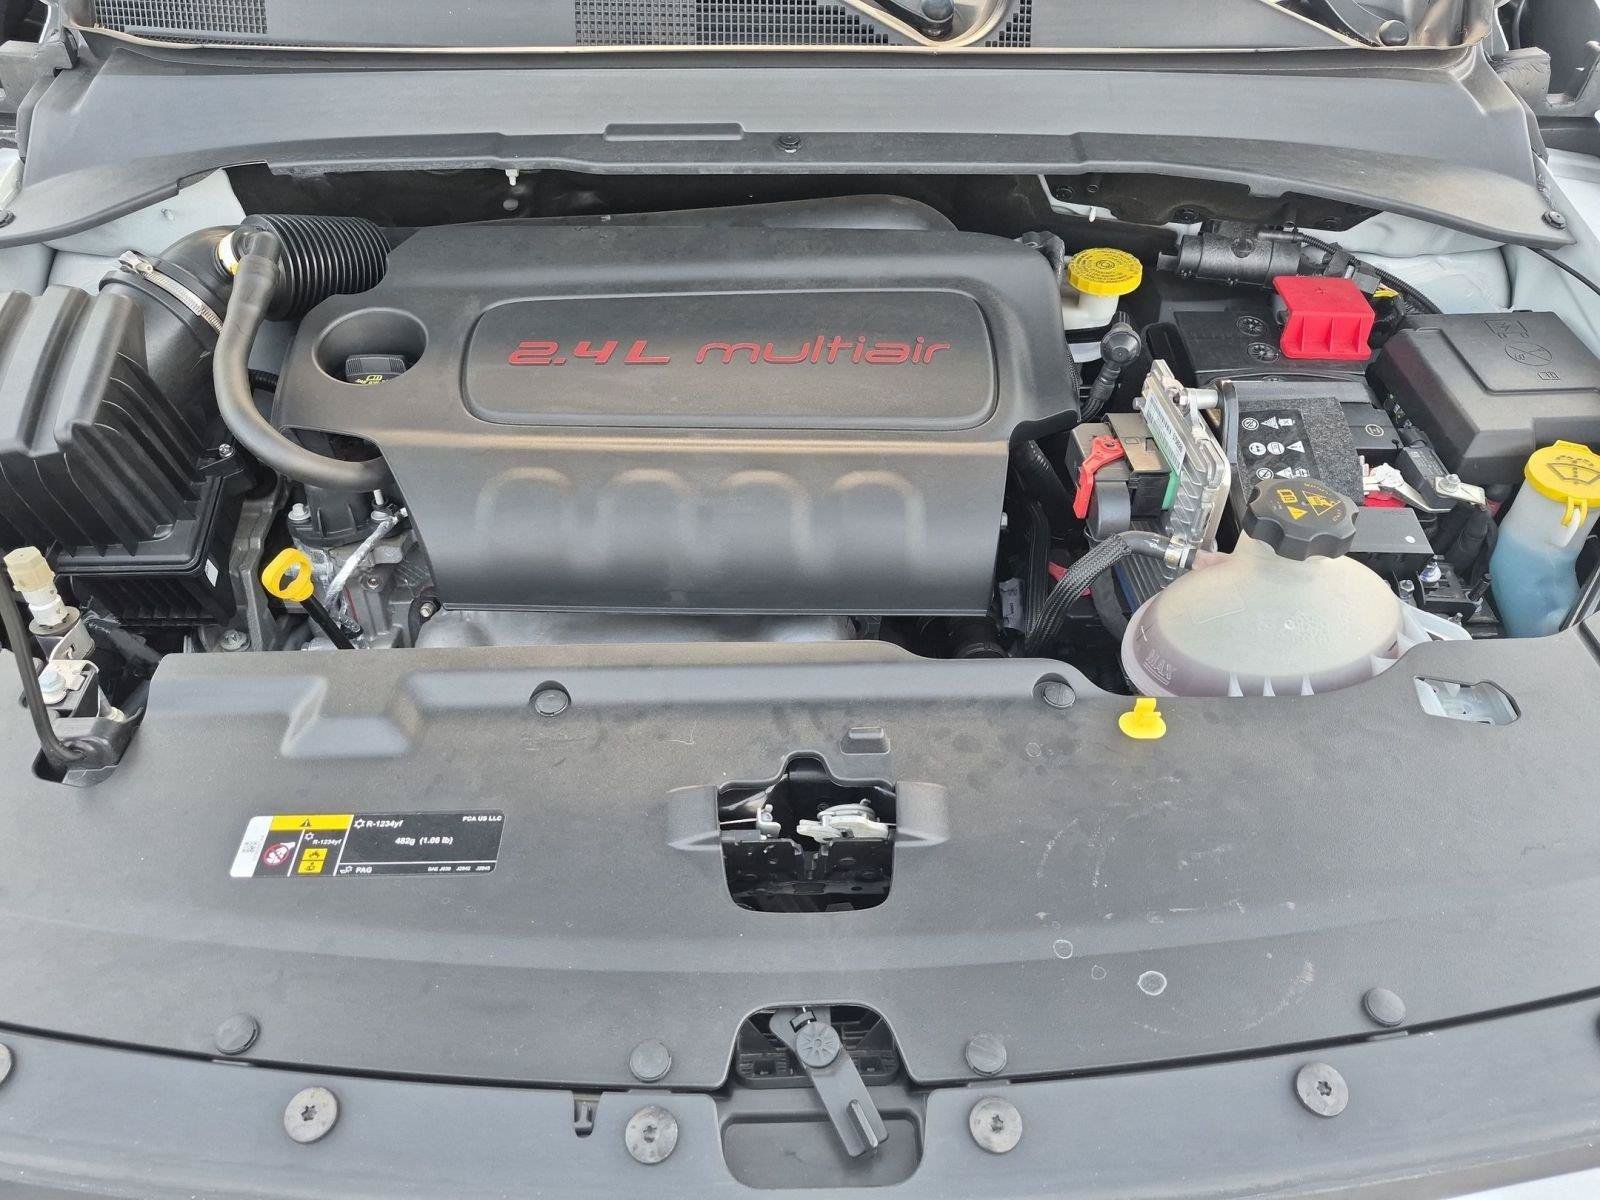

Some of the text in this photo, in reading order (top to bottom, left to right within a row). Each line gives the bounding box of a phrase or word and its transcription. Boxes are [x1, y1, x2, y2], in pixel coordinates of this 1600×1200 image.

[695, 334, 951, 365] multiair
[1144, 649, 1177, 681] MAX
[366, 819, 404, 828] R-1234yf
[441, 836, 454, 845] lb)
[355, 866, 373, 874] PAG
